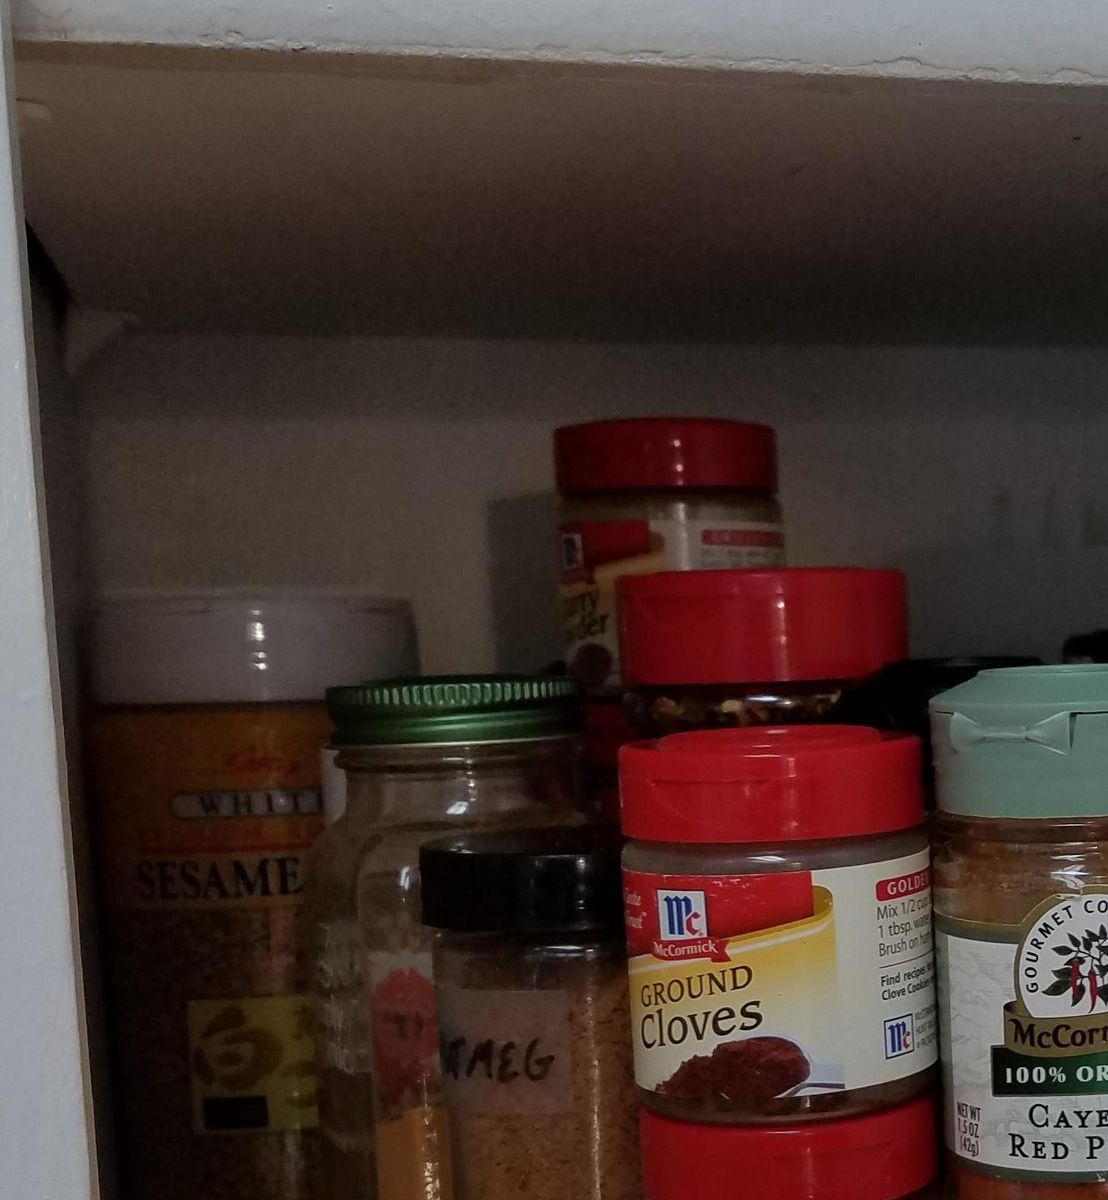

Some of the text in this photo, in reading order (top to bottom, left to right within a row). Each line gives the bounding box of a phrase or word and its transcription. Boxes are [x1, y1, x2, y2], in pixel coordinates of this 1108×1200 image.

[138, 857, 304, 900] SESAME
[877, 904, 898, 920] Mix
[653, 940, 719, 957] McCormick
[879, 938, 907, 957] Brush
[1024, 905, 1074, 993] GOURMET
[641, 965, 753, 1008] GROUND
[881, 971, 901, 987] Find
[882, 987, 906, 1001] Clove
[641, 1000, 763, 1049] Cloves
[1005, 1065, 1067, 1084] 100%
[1008, 1132, 1069, 1160] RED
